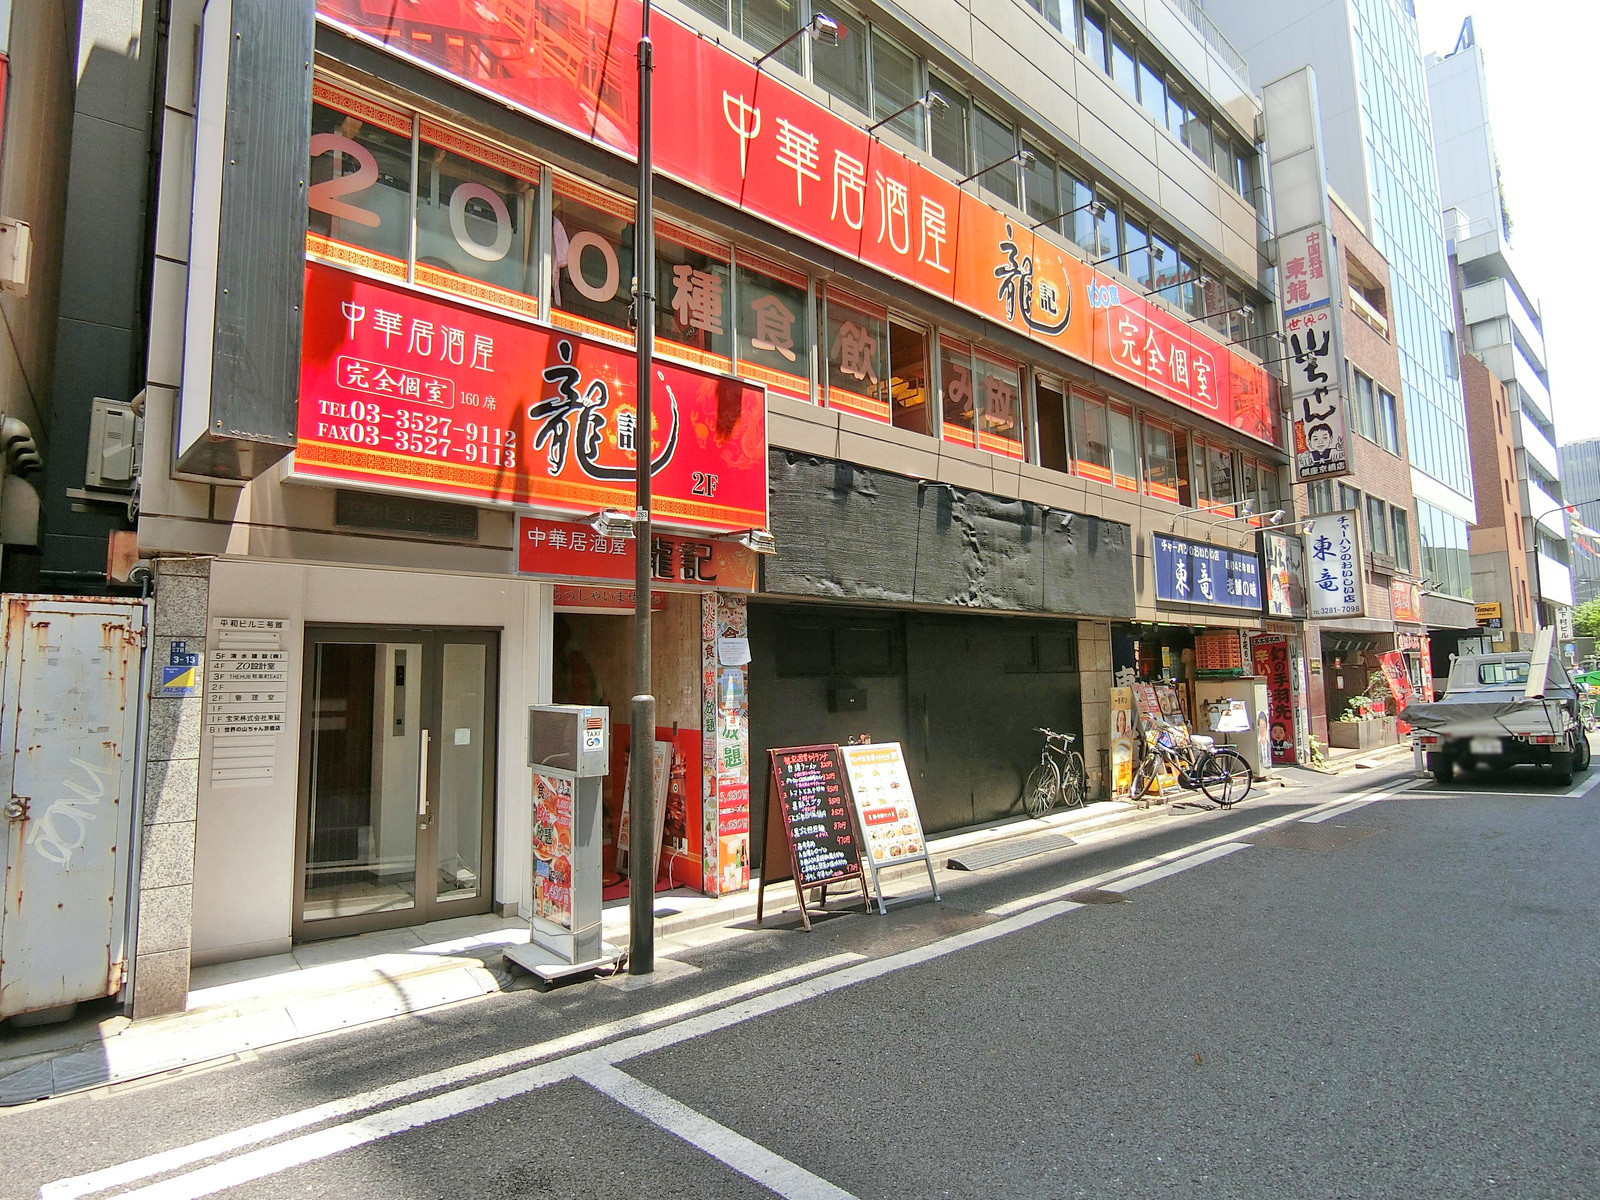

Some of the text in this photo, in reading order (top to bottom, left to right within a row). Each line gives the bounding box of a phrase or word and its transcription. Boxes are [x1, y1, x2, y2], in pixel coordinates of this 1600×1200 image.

[723, 91, 950, 274] 中華居酒屋
[1306, 232, 1324, 280] 中国料理
[1285, 257, 1310, 303] 東龍
[341, 300, 495, 373] 中華居酒屋
[1287, 313, 1328, 331] 世界の
[1118, 318, 1211, 400] 完全個室
[1291, 328, 1336, 423] 山ちゃん
[346, 363, 448, 405] 完全個室
[692, 471, 719, 497] 2F
[527, 526, 627, 556] 中華居酒屋
[1337, 516, 1356, 603] チャーハンのおいしい店
[1175, 558, 1213, 600] 東竜
[1312, 535, 1339, 592] 東竜
[220, 619, 283, 629] 平和ビル三号館
[173, 655, 196, 664] 3-13
[1255, 649, 1271, 675] 辛い
[586, 737, 601, 747] GO
